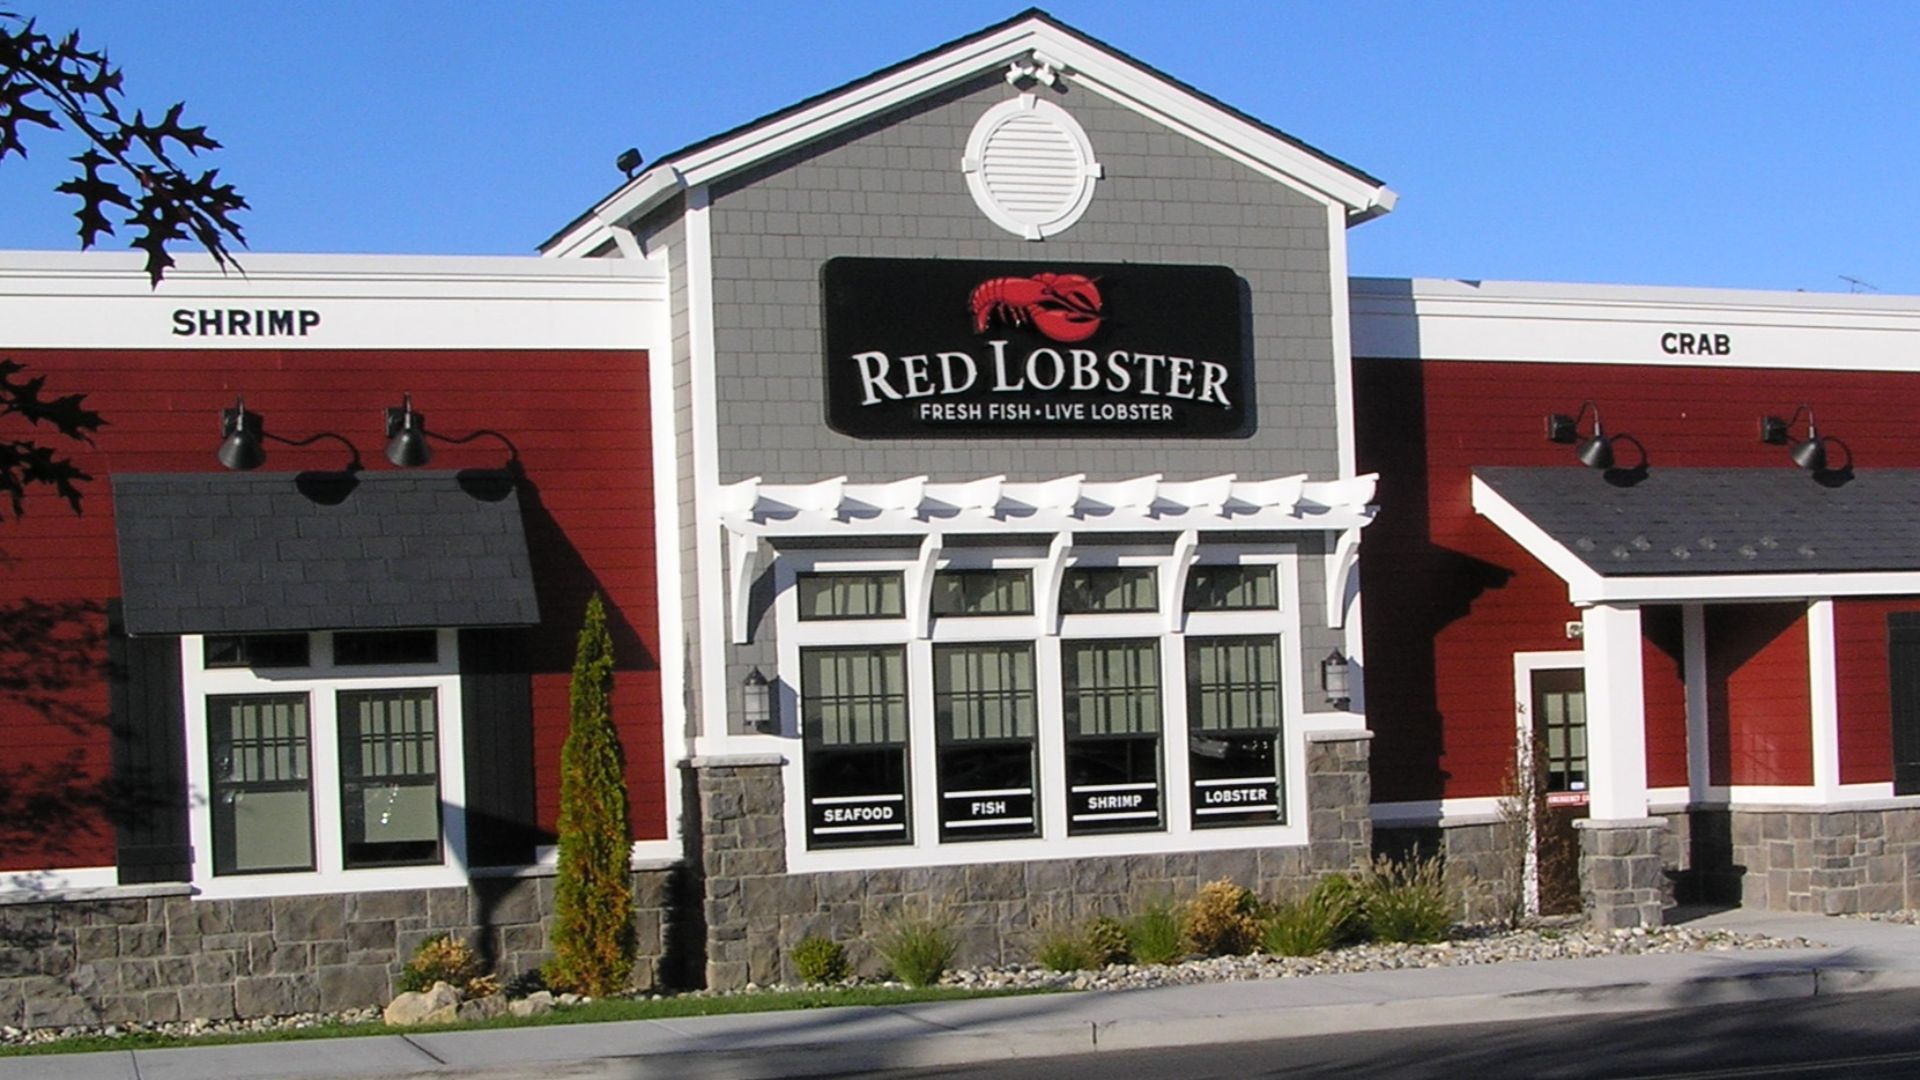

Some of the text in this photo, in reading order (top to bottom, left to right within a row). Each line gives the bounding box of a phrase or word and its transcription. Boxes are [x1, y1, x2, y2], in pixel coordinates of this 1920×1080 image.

[172, 309, 321, 336] SHRIMP
[1661, 332, 1730, 355] CRAB
[852, 340, 1232, 407] RED LOBSTER
[920, 403, 1173, 421] FRESH FISH LIVE LOBSTER
[1087, 794, 1143, 810] SHRIMP
[1205, 788, 1267, 804] LOBSTER
[823, 805, 894, 823] SEAFOOD
[971, 801, 1006, 815] FISH
